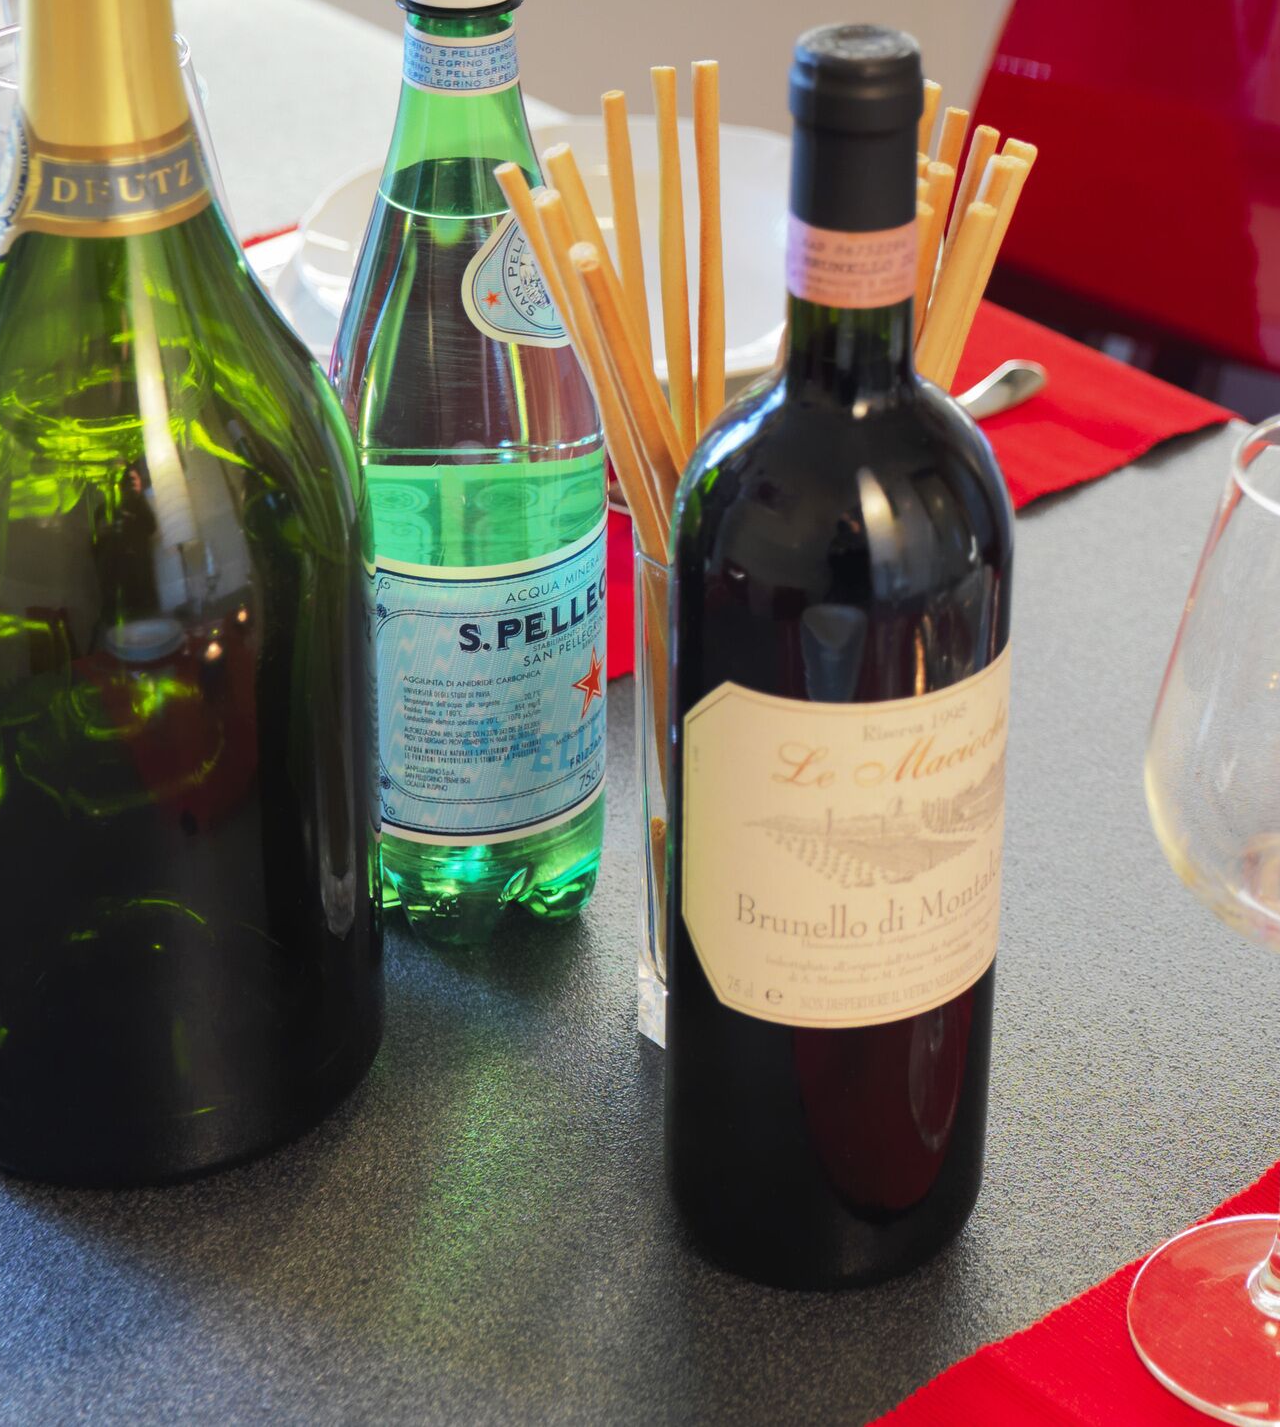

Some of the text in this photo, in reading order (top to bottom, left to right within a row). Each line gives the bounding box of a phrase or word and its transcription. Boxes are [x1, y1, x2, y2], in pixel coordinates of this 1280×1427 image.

[513, 285, 538, 317] SAN
[506, 580, 560, 605] ACQUA
[523, 648, 553, 667] SAN
[862, 723, 925, 743] Riserva
[772, 740, 836, 790] Le
[737, 892, 868, 939] Brunello
[878, 897, 905, 934] di
